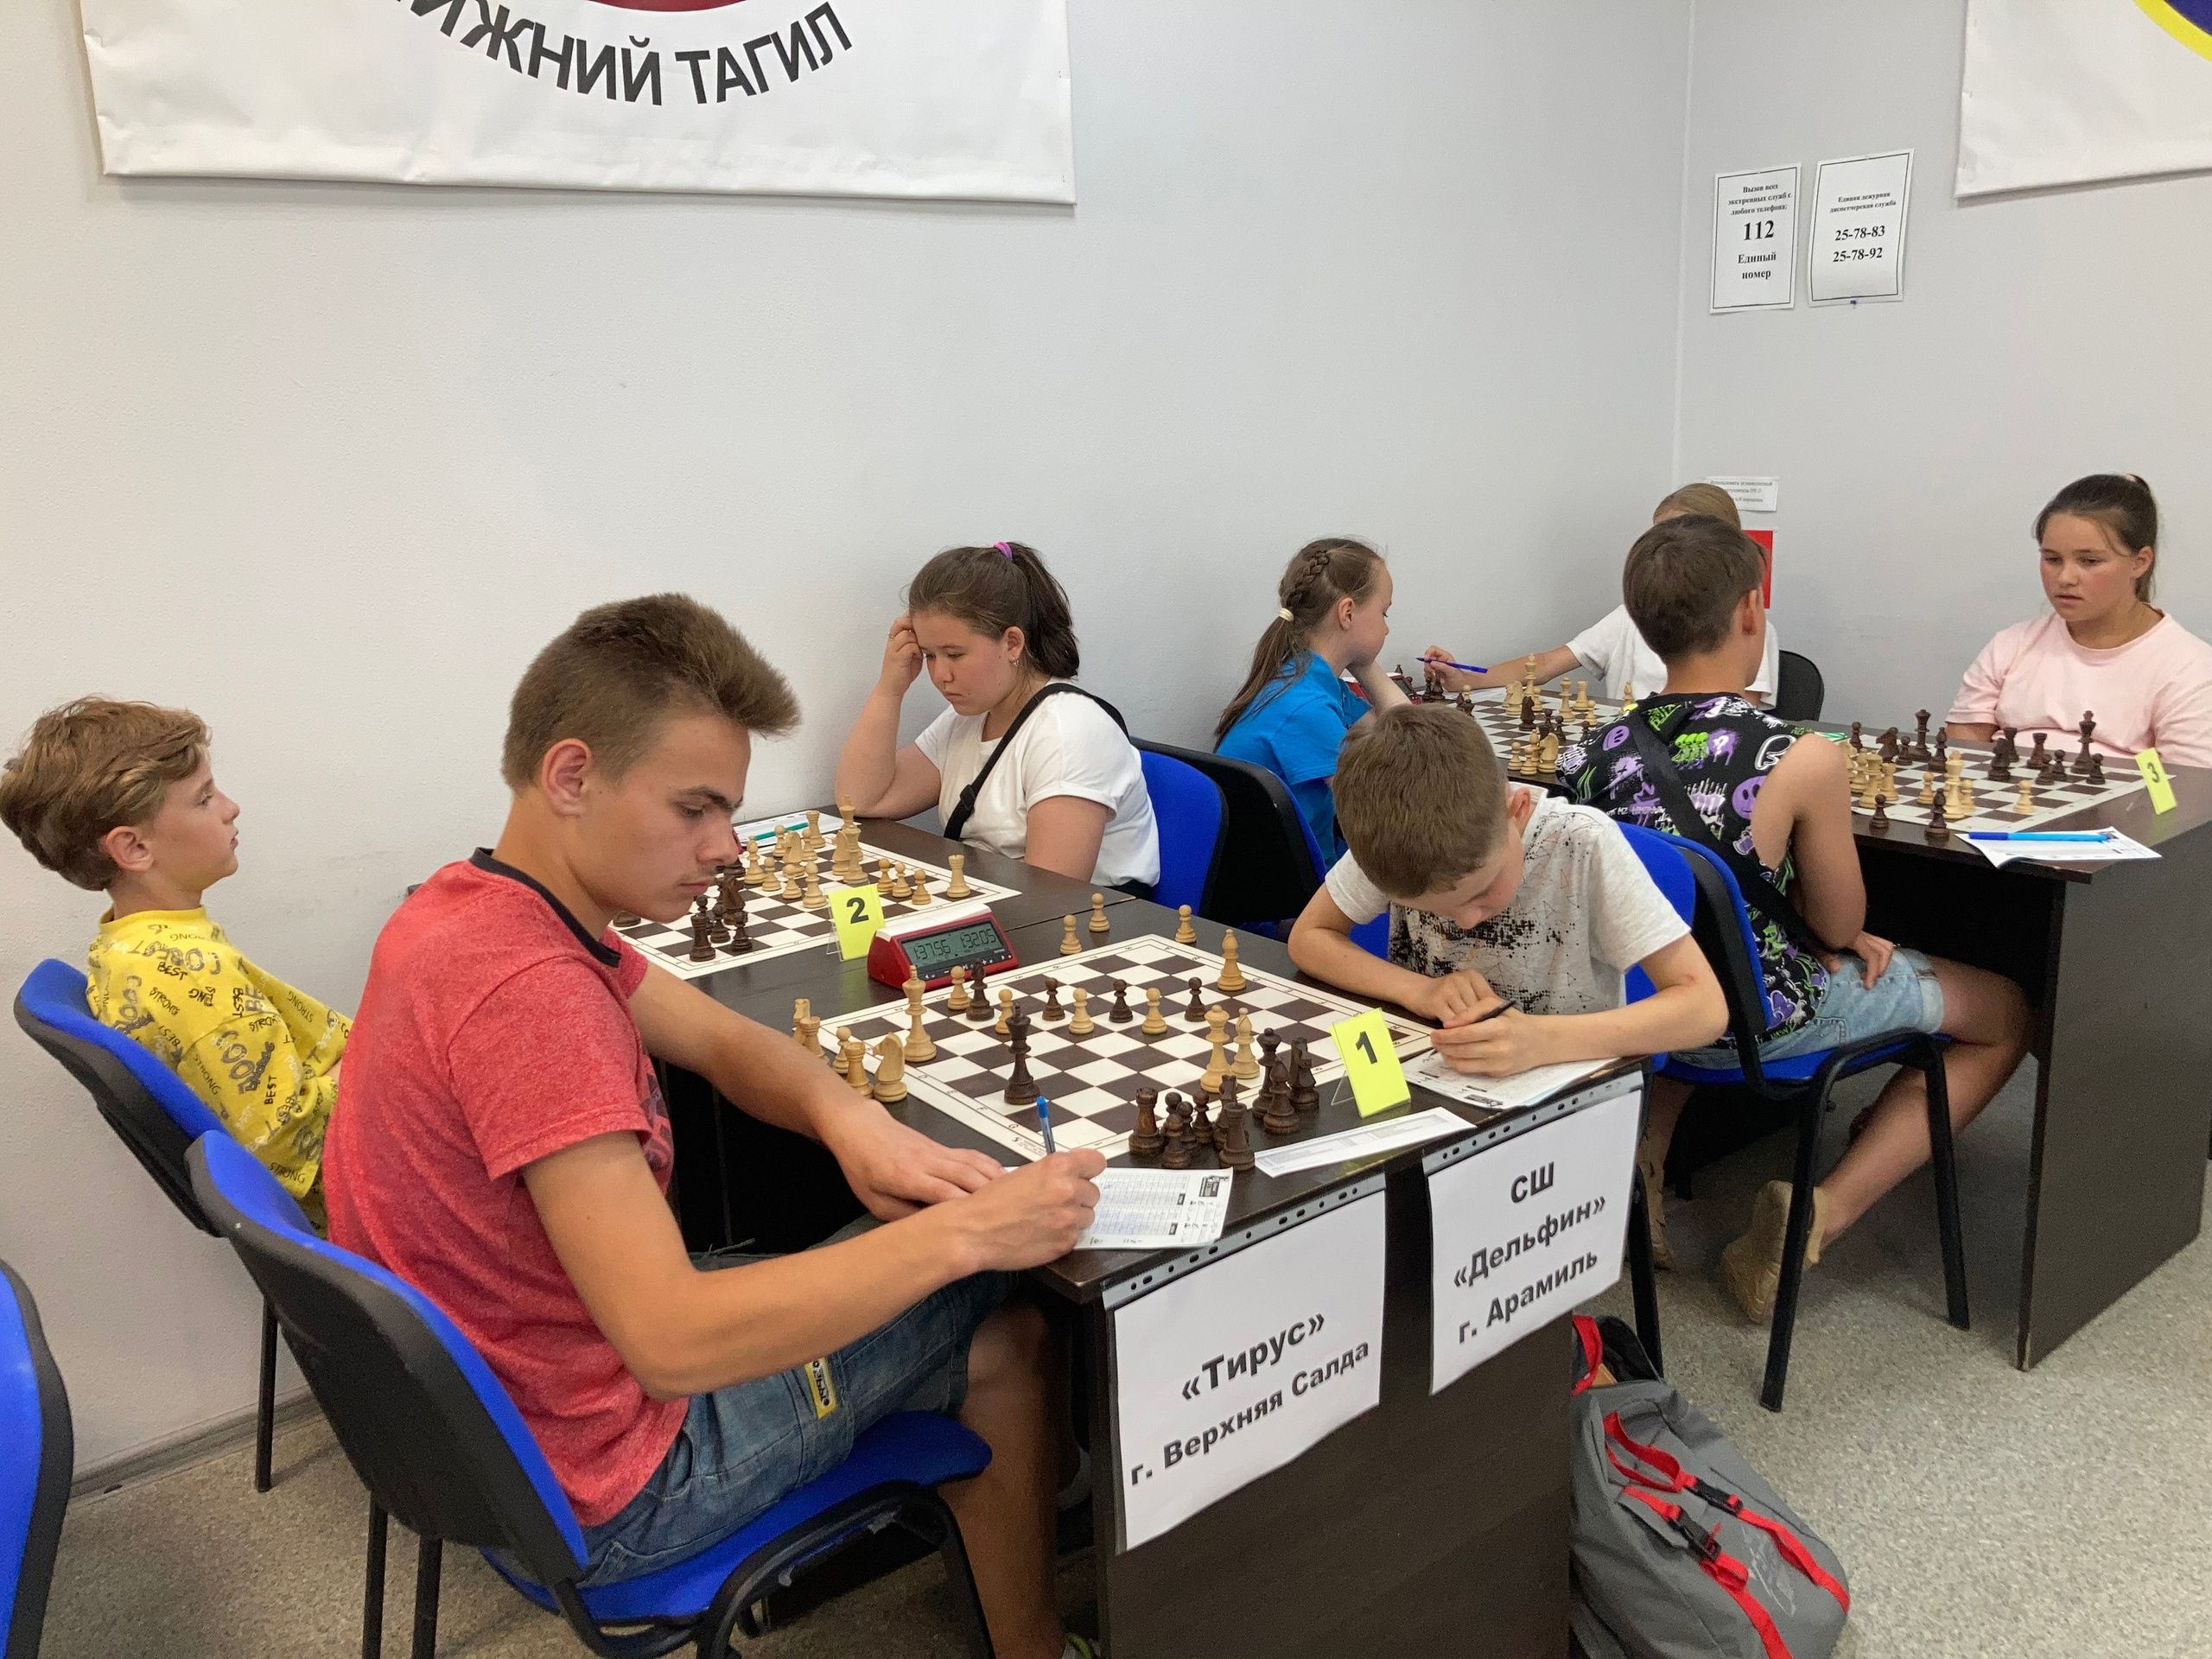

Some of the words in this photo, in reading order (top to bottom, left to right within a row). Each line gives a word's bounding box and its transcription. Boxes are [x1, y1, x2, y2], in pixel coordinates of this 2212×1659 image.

[397, 0, 662, 106] ИЖНИЙ
[675, 1, 853, 105] ТАГИЛ
[1743, 219, 1775, 241] 112
[1834, 225, 1885, 241] 25-78-83
[1737, 251, 1777, 264] Единый
[1833, 247, 1883, 263] 25-78-92
[1742, 270, 1771, 280] номер
[2147, 762, 2159, 783] 3
[846, 897, 869, 925] 2
[157, 961, 188, 981] BEST
[149, 987, 180, 1016] STRONG
[232, 987, 244, 1018] BEST
[287, 991, 315, 1023] STRONG
[1355, 1031, 1377, 1065] 1
[264, 1075, 276, 1105] BEST
[1510, 1161, 1554, 1204] СШ
[1453, 1196, 1605, 1287] «Дельфин»
[1459, 1320, 1478, 1344] г.
[1486, 1251, 1598, 1328] Арамиль
[1182, 1313, 1325, 1401] «Тирус»
[1131, 1464, 1153, 1486] г.
[1163, 1389, 1282, 1469] Верхняя
[1292, 1341, 1369, 1397] Салда
